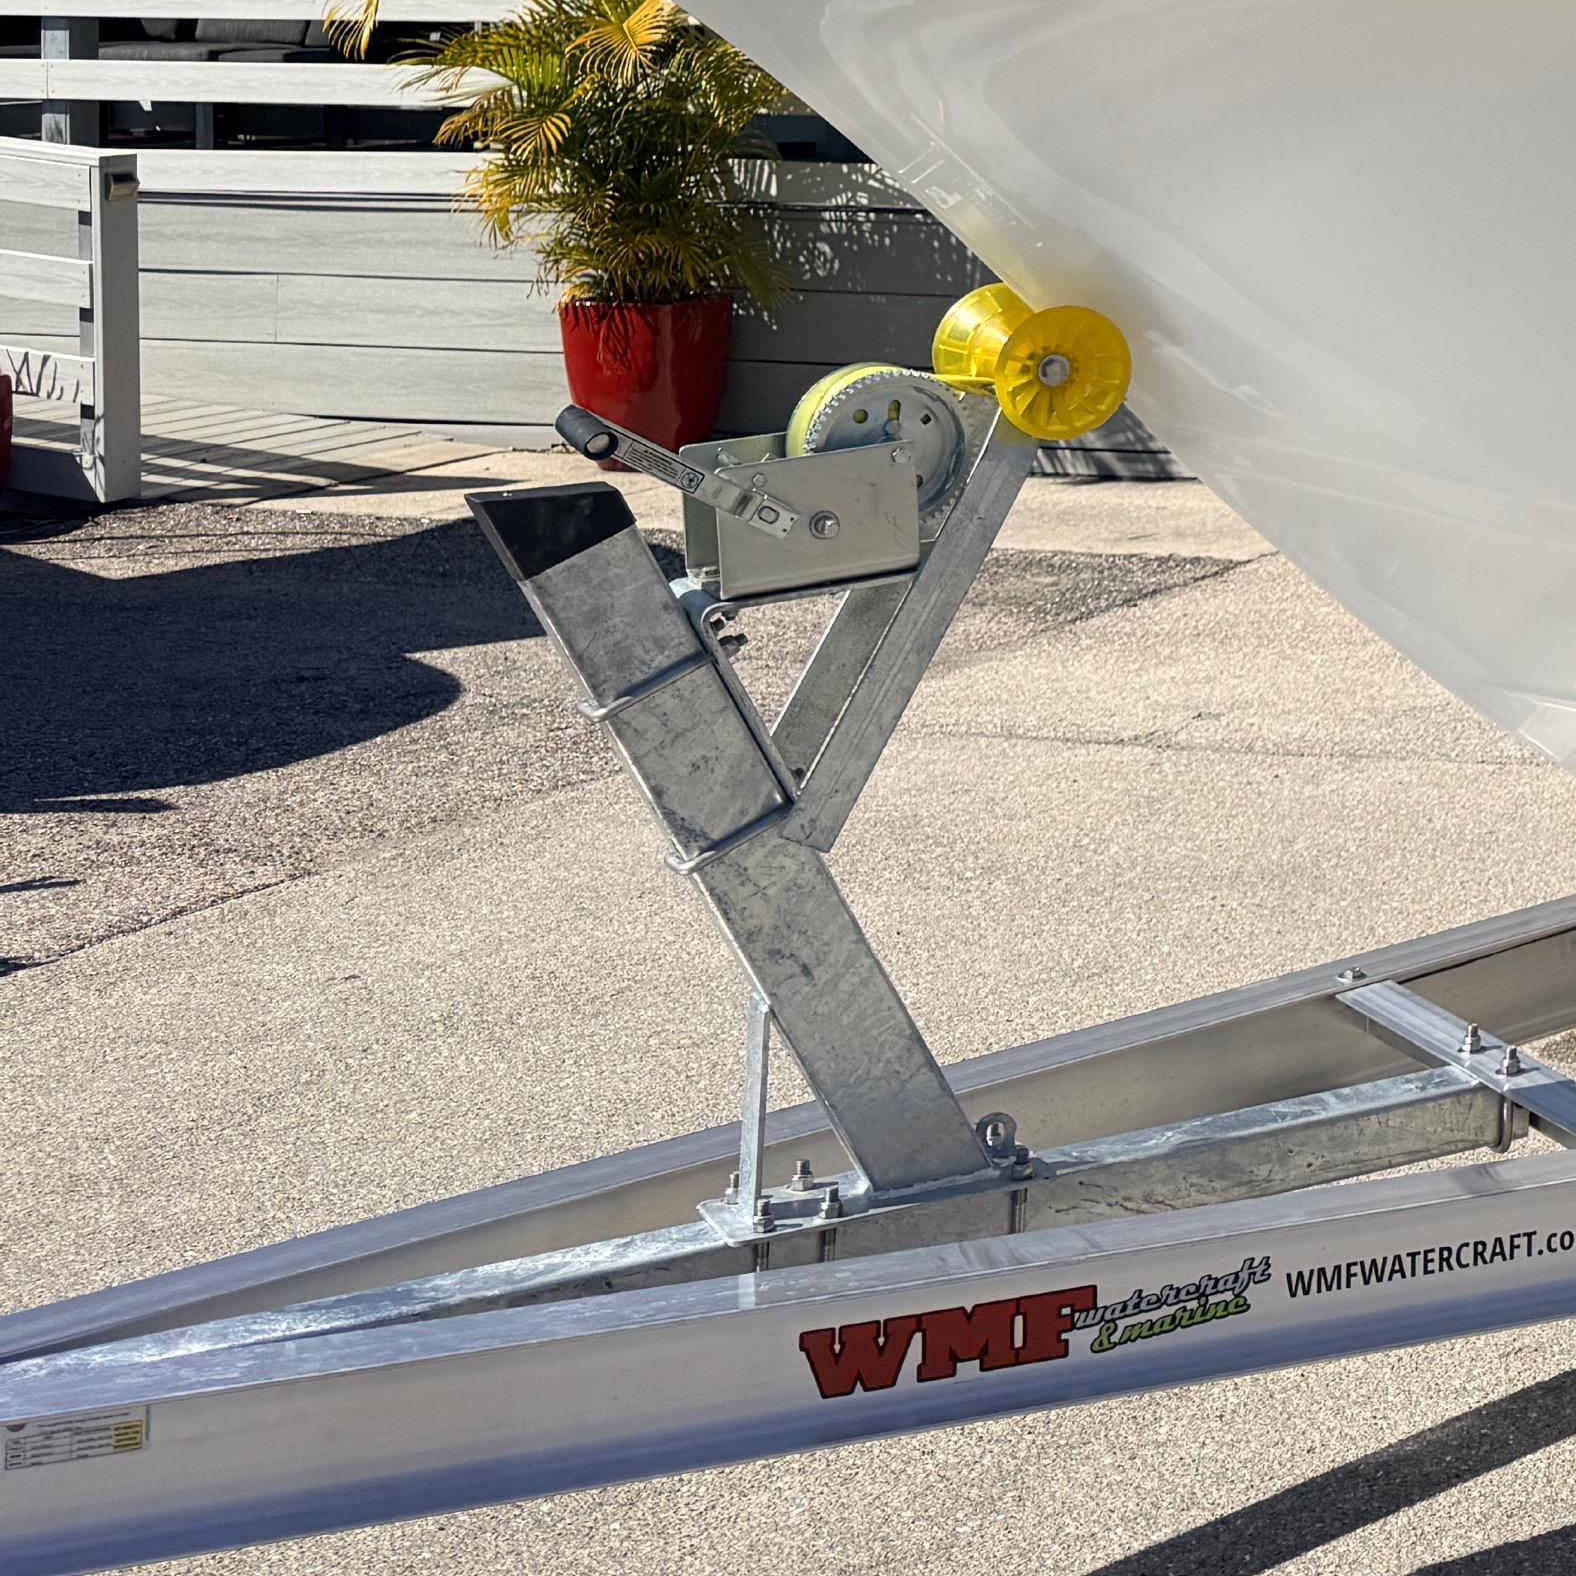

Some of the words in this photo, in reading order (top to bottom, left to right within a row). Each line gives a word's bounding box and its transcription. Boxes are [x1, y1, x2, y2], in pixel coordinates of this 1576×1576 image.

[1073, 1255, 1273, 1330] watercraft
[1091, 1325, 1117, 1354] &
[1117, 1293, 1251, 1346] marine
[799, 1284, 1098, 1400] WMF
